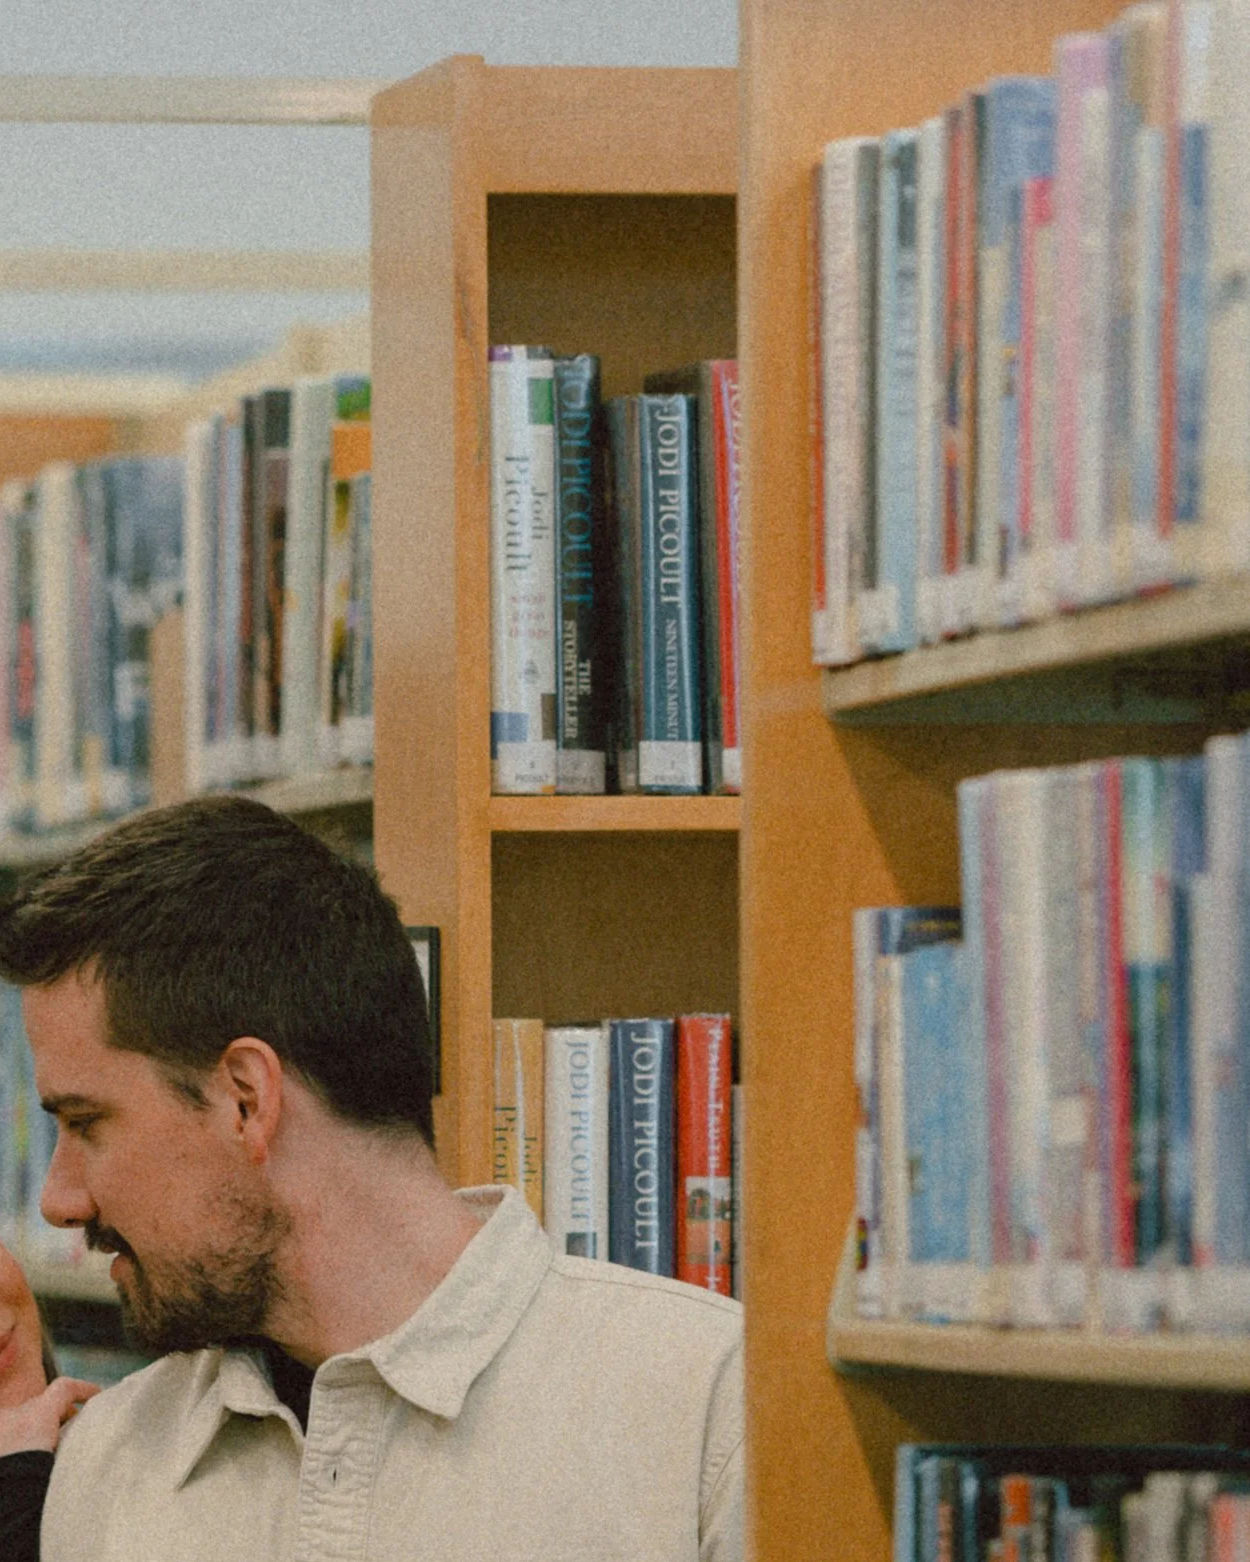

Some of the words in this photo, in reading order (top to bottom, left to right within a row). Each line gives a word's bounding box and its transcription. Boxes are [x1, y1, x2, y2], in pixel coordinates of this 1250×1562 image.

[654, 409, 682, 475] JODI
[505, 454, 532, 572] Picoult
[531, 486, 550, 541] Jodi
[562, 455, 595, 608] PICOULT
[658, 488, 683, 608] PICOULT
[563, 620, 578, 739] STORYTELLER
[579, 659, 591, 696] THE
[664, 618, 678, 690] NINETEEN
[566, 1040, 590, 1099] JODI
[631, 1032, 660, 1103] JODI
[570, 1110, 591, 1220] PICOULT
[634, 1120, 660, 1250] PICOULT
